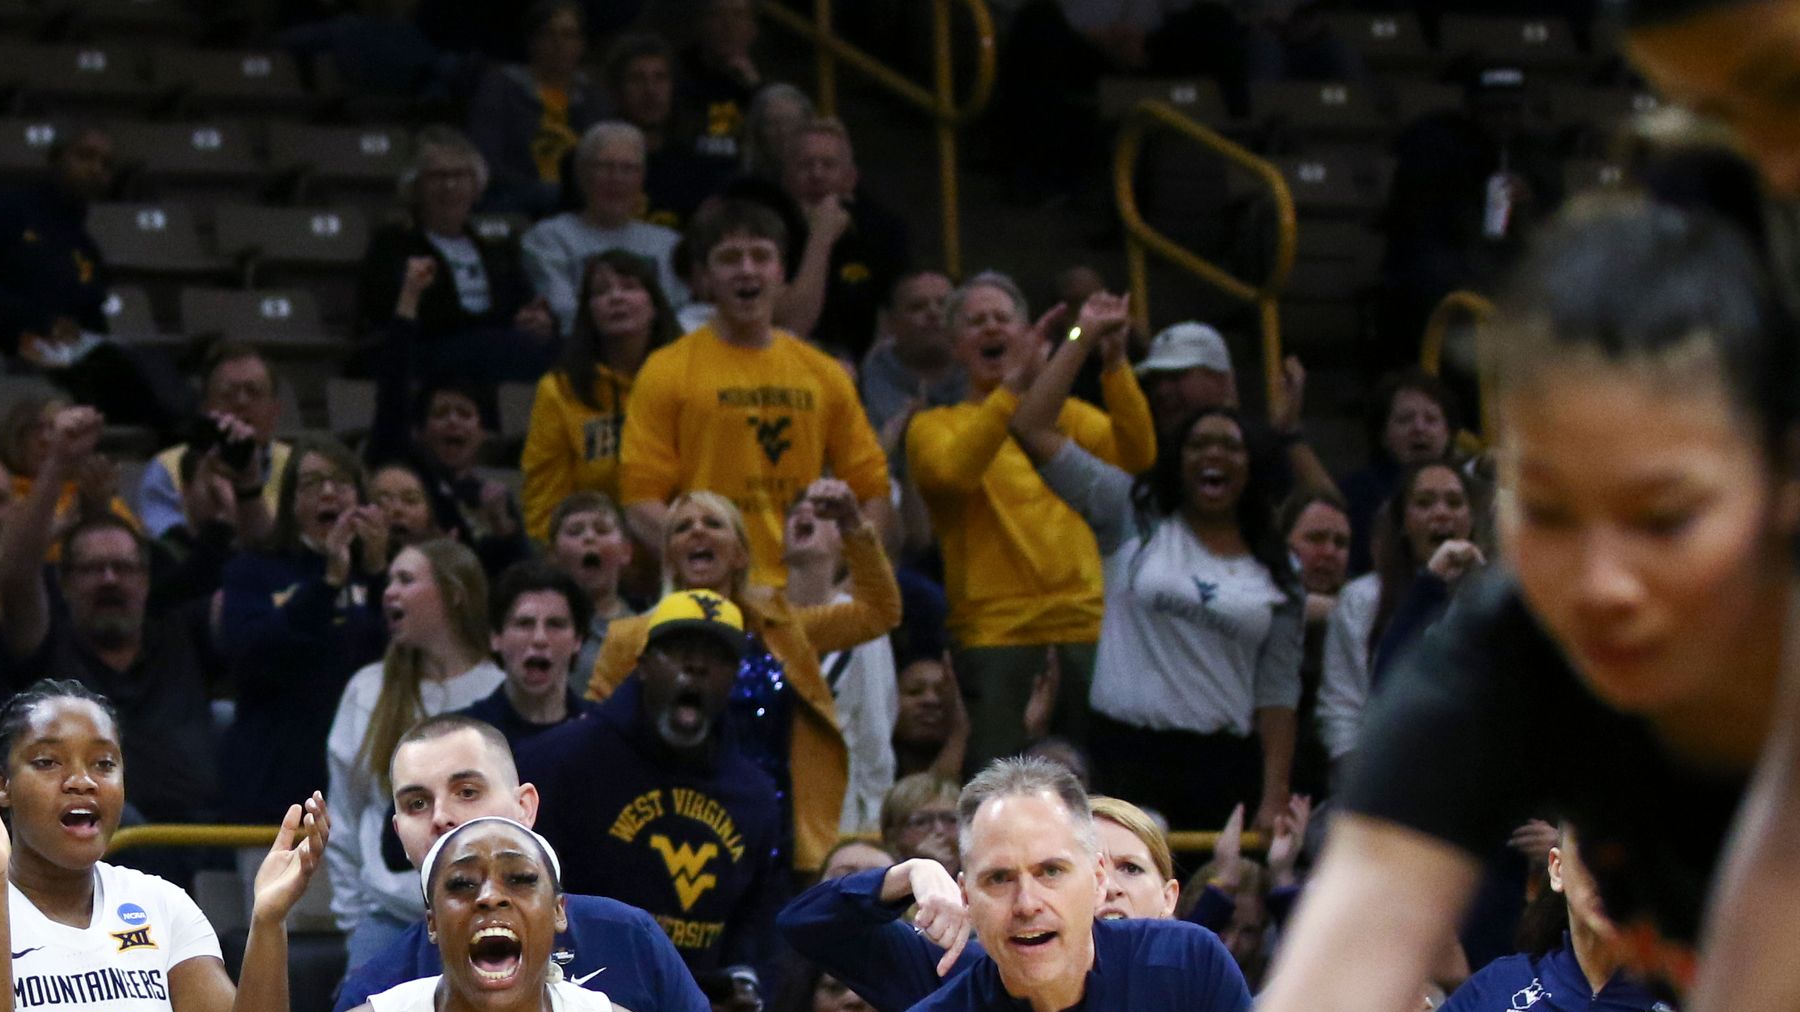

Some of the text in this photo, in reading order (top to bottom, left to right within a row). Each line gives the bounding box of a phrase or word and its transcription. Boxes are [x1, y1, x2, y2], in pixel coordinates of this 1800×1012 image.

[608, 787, 746, 864] WEST VIRGINIA
[13, 967, 167, 1009] MOUNTAINEERS
